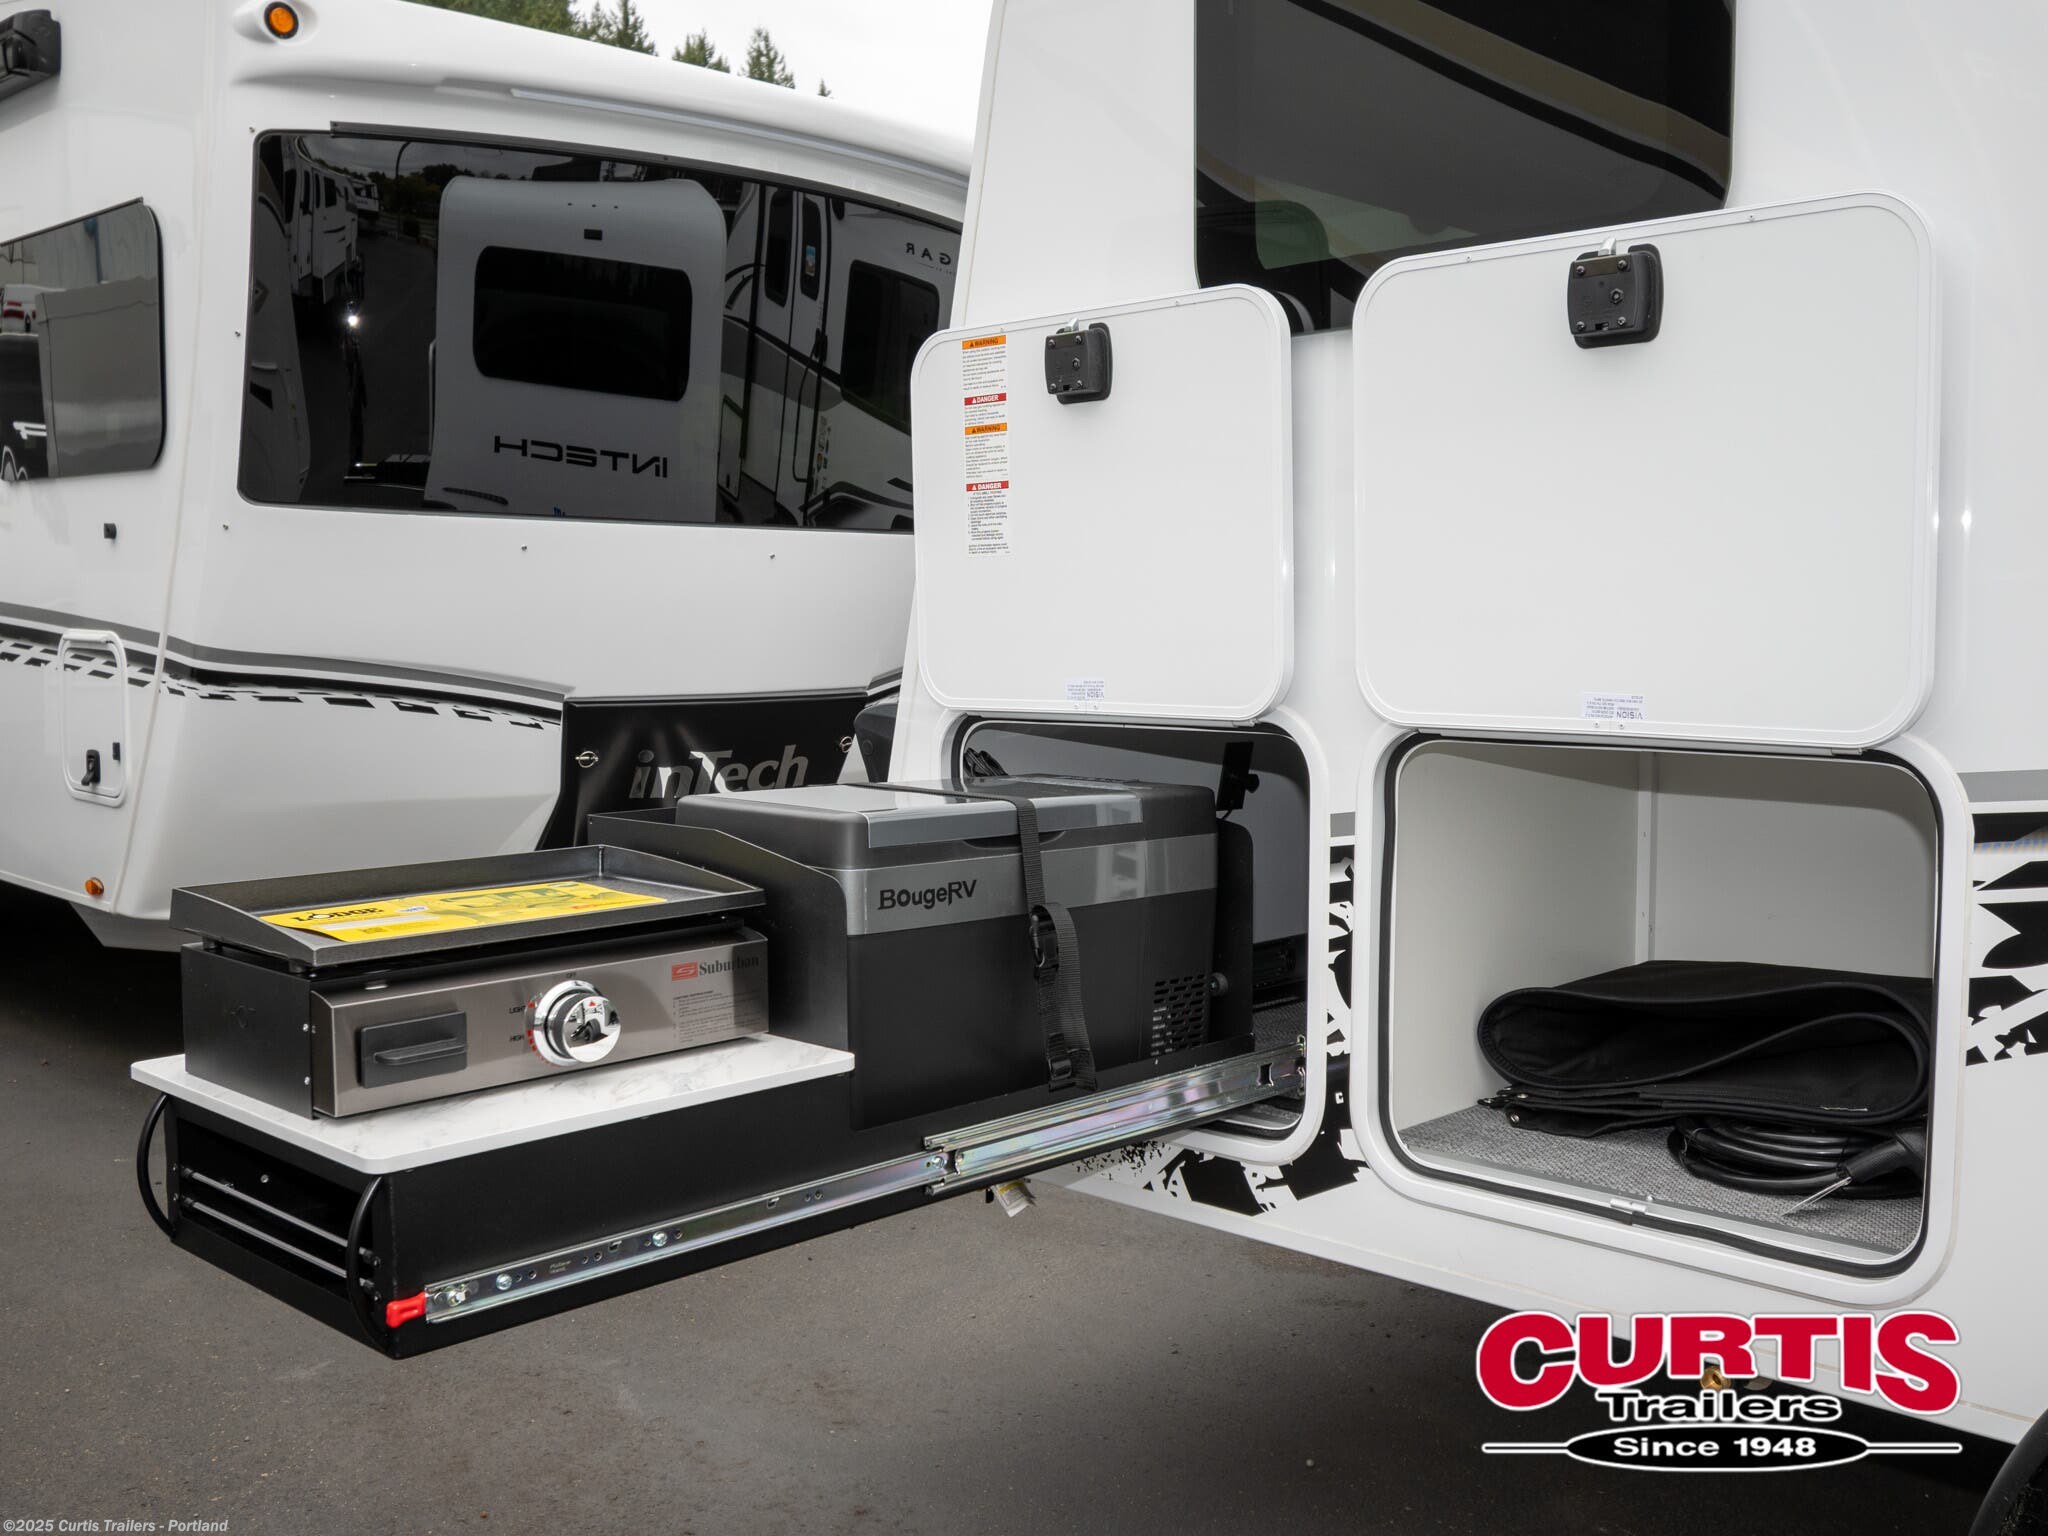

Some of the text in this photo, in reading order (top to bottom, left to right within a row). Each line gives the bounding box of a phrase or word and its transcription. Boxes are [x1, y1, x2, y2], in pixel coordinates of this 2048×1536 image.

[974, 337, 999, 347] WARNING
[976, 394, 999, 403] DANGER
[977, 424, 1001, 434] WARNING
[977, 482, 1002, 490] DANGER
[1616, 711, 1643, 719] VISION
[628, 744, 809, 799] inTech
[877, 879, 978, 910] BougeRV
[699, 955, 760, 976] Suburban
[508, 1005, 526, 1014] LIGHT
